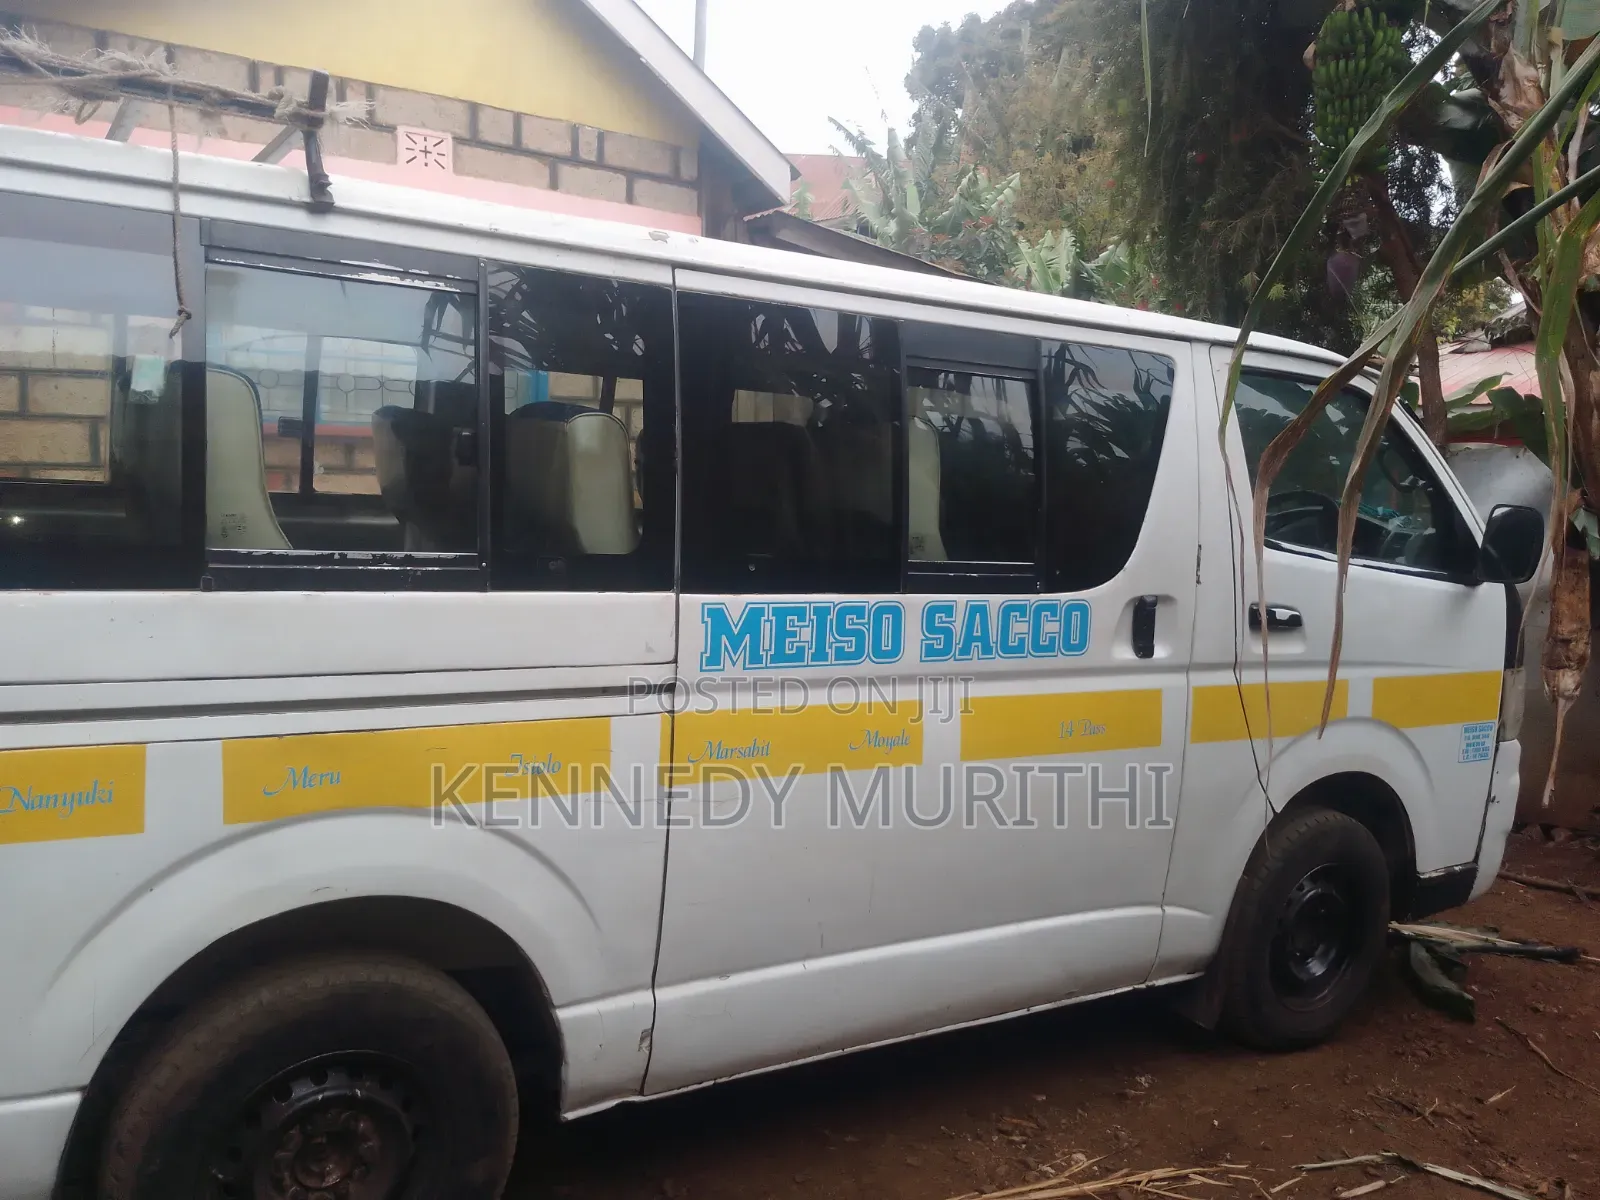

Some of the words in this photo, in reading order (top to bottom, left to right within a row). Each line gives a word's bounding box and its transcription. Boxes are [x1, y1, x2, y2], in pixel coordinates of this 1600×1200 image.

[700, 600, 905, 672] MEISO
[919, 599, 1093, 662] SACCO
[848, 728, 911, 755] Moyale
[1058, 720, 1074, 739] 14
[688, 738, 771, 763] Marsabit
[262, 765, 341, 797] Meru
[0, 779, 114, 819] Nanyuki
